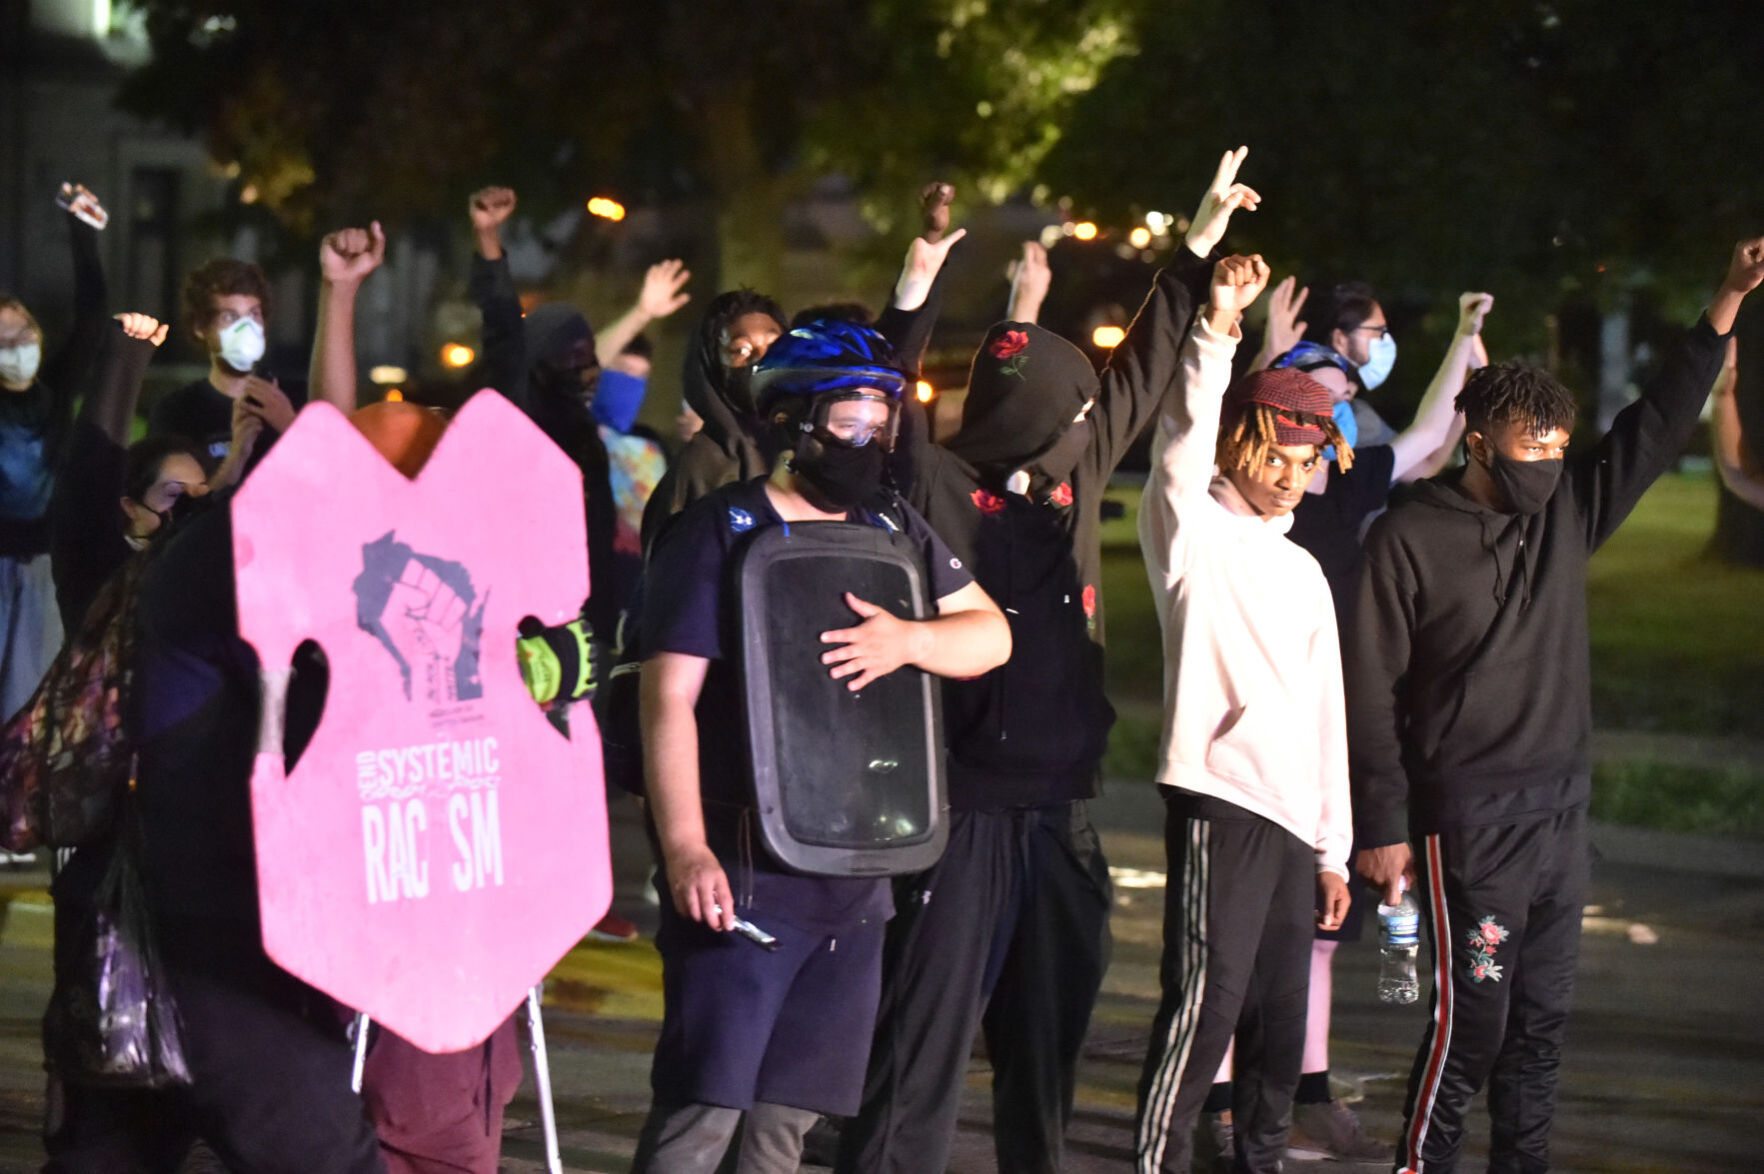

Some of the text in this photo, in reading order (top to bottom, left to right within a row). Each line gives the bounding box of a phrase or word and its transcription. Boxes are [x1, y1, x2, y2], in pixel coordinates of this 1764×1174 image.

[356, 751, 377, 789] END
[378, 736, 500, 786] SYSTEMIC
[361, 789, 504, 904] RACSM
